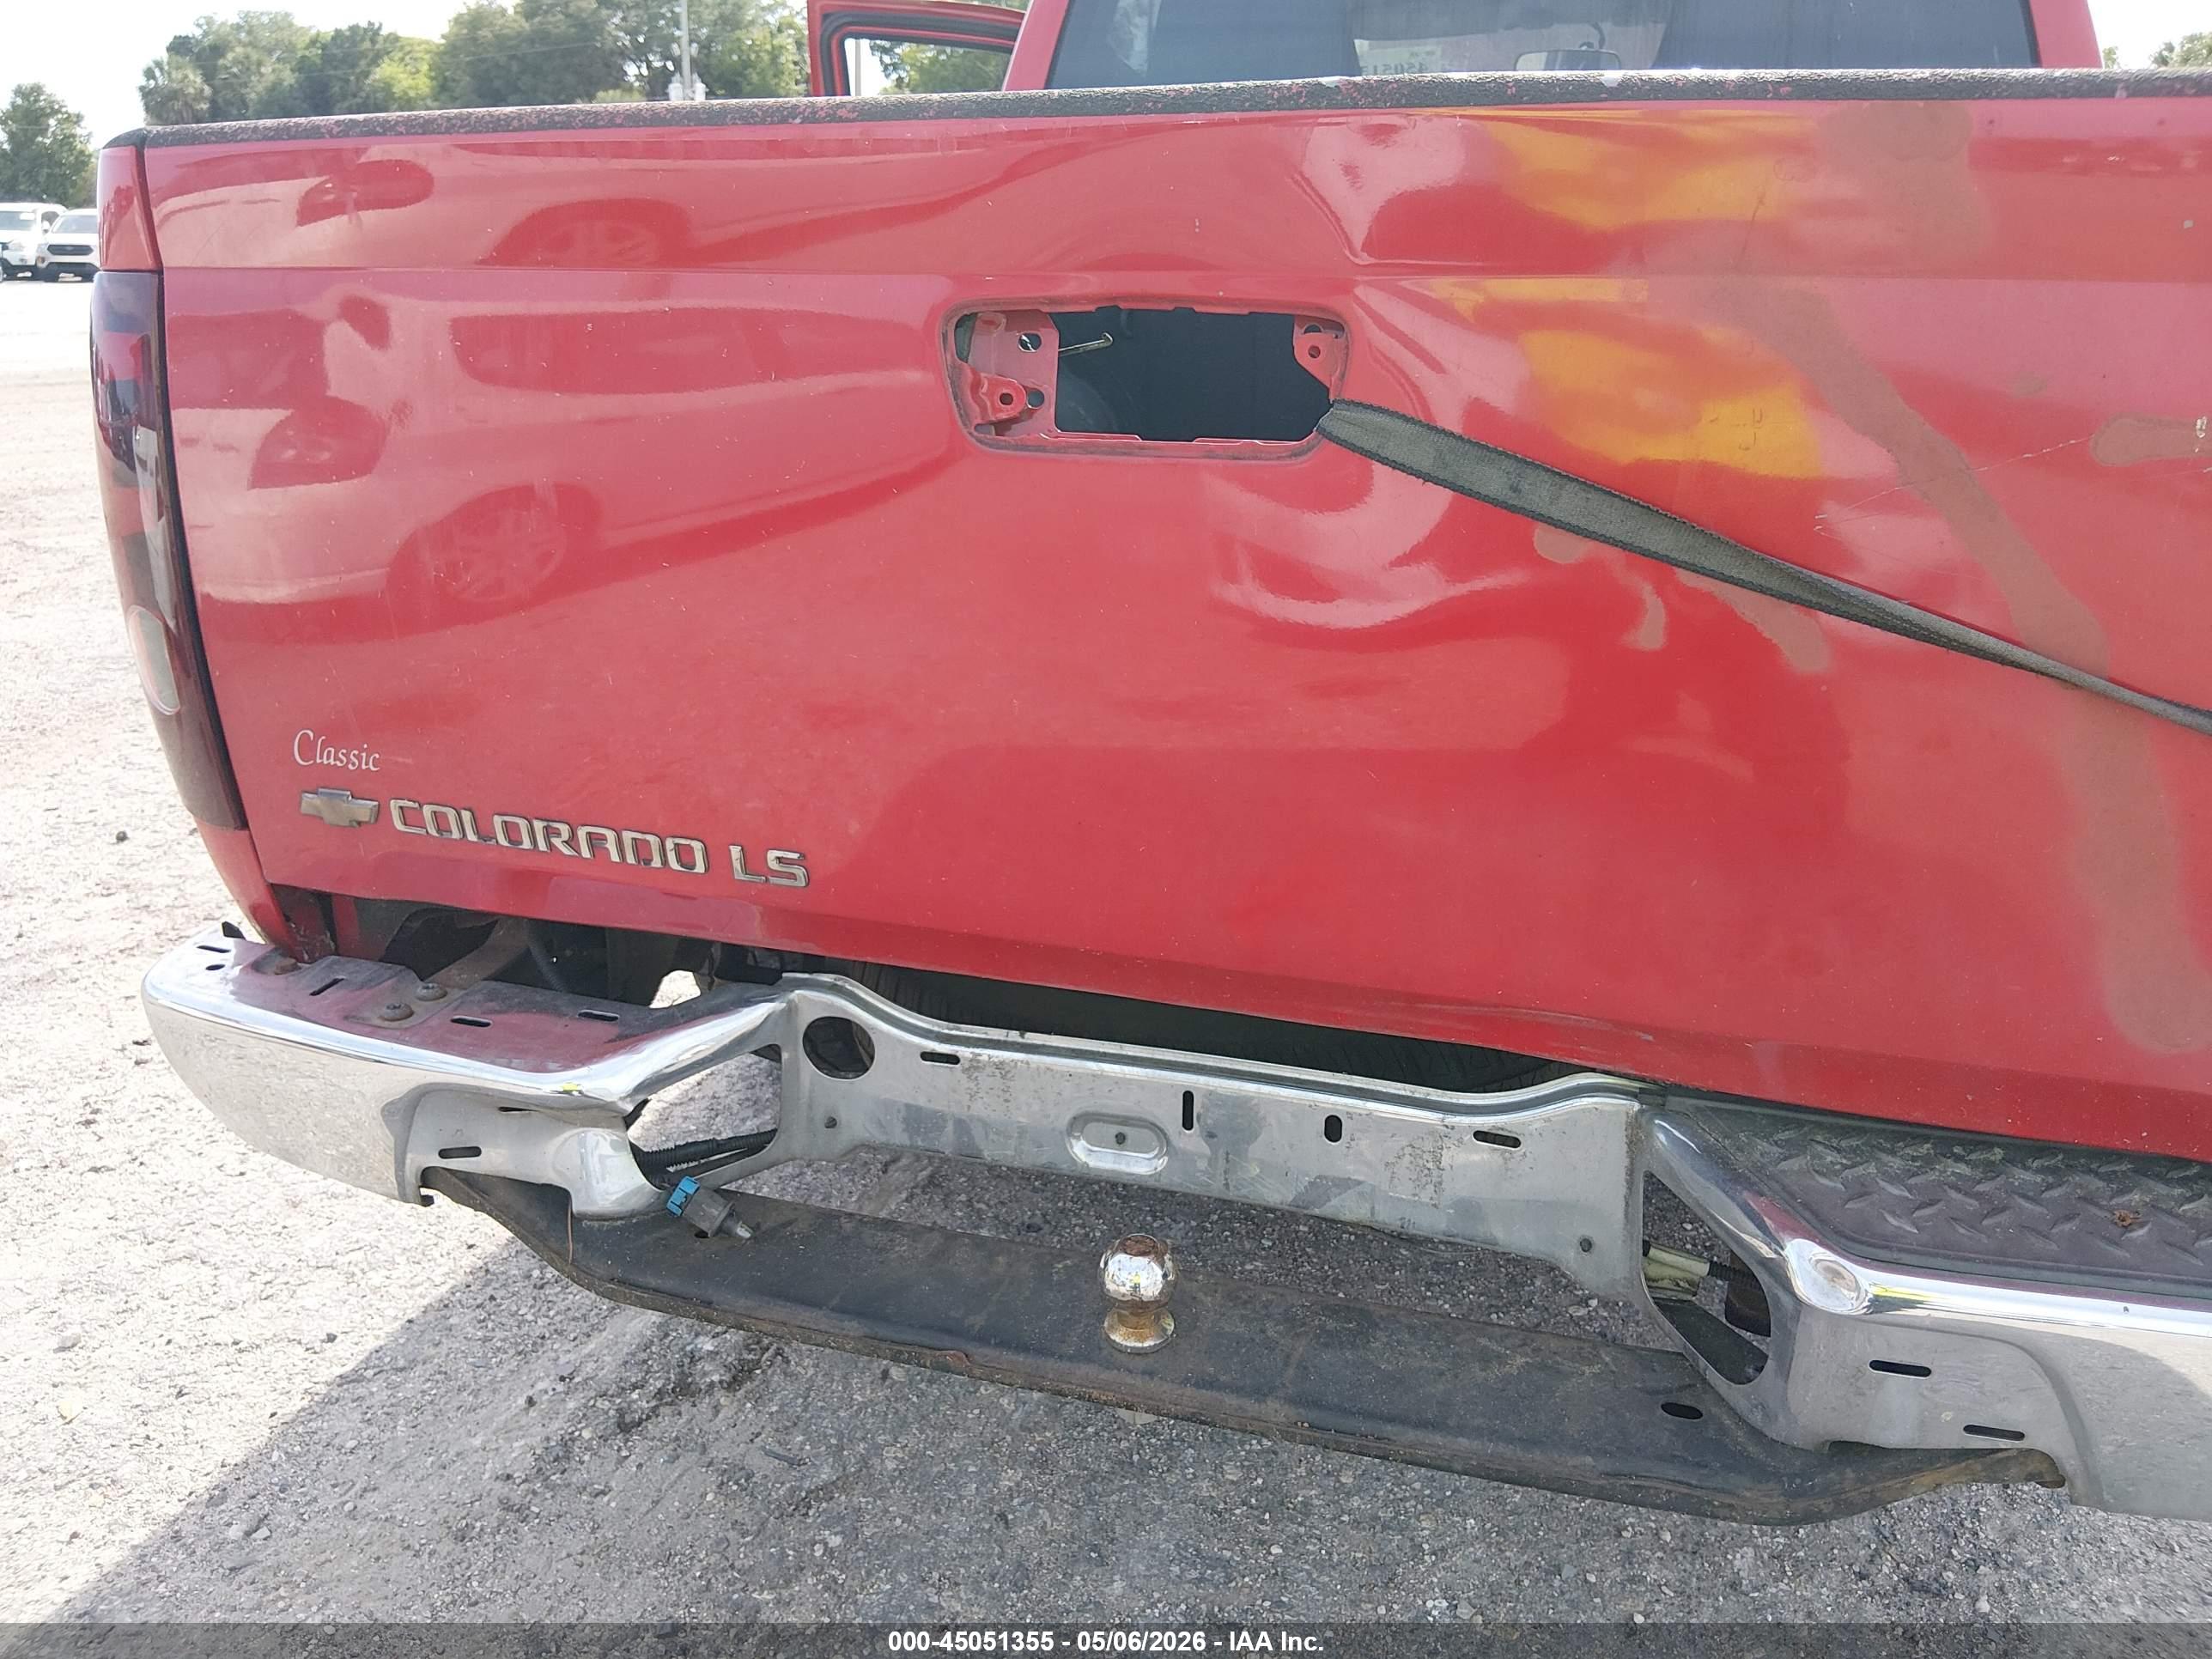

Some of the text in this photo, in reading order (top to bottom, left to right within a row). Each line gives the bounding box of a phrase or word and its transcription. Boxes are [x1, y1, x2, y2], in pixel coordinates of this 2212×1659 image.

[294, 729, 380, 771] Classic
[390, 799, 809, 888] COLORADO LS
